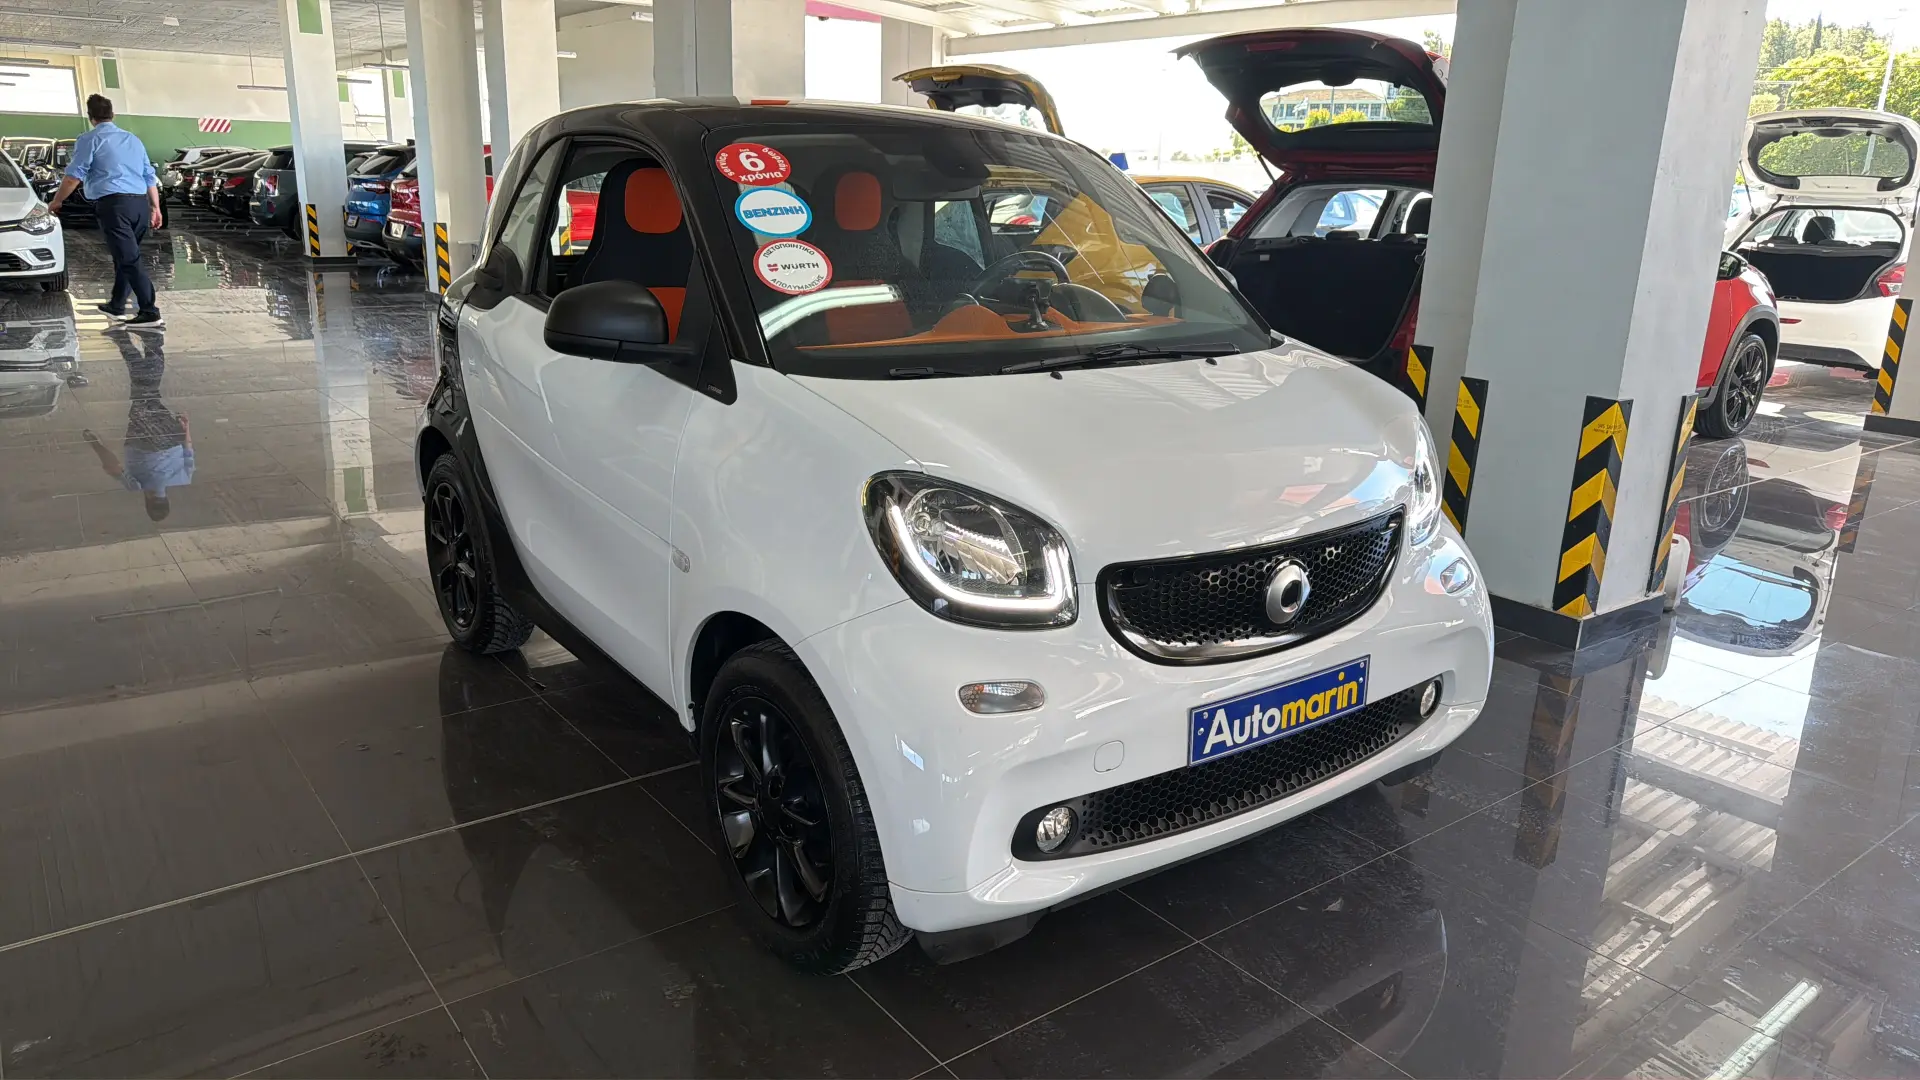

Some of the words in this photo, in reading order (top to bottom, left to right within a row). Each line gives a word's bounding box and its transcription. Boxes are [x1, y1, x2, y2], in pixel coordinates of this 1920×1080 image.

[717, 152, 736, 177] service
[739, 151, 766, 172] 6
[739, 171, 784, 182] χρόνια
[743, 206, 805, 219] ΒΕΝΖΙΝΗ
[763, 242, 815, 258] ΠΙΣΤΟΠΟΙΗΤΙΚΟ
[770, 274, 825, 290] ΑΠΟΛΥΜΑΝΣΗΣ
[1203, 671, 1358, 755] Automarin
